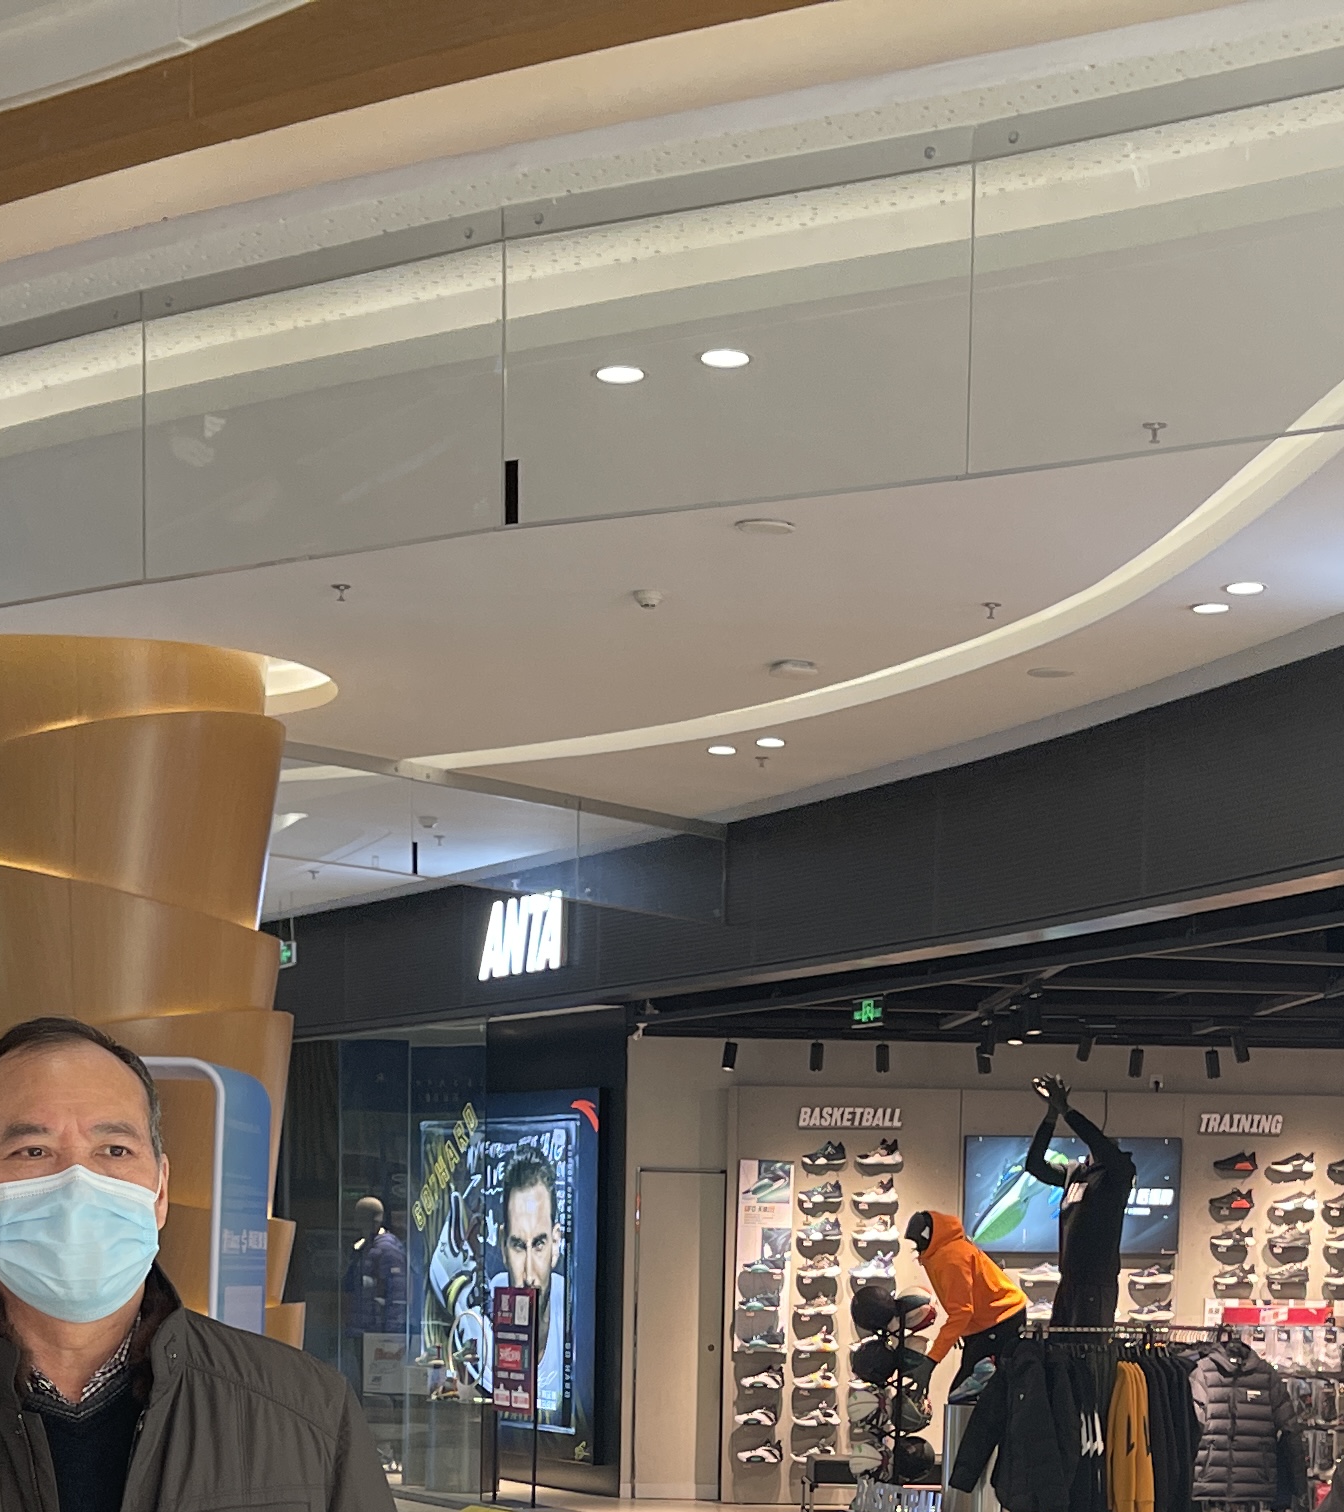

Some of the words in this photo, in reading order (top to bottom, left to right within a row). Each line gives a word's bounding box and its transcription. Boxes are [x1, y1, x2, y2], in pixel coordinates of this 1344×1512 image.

[478, 890, 563, 981] ANTA
[798, 1107, 903, 1128] BASKETBALL
[1199, 1113, 1284, 1135] TRAINING
